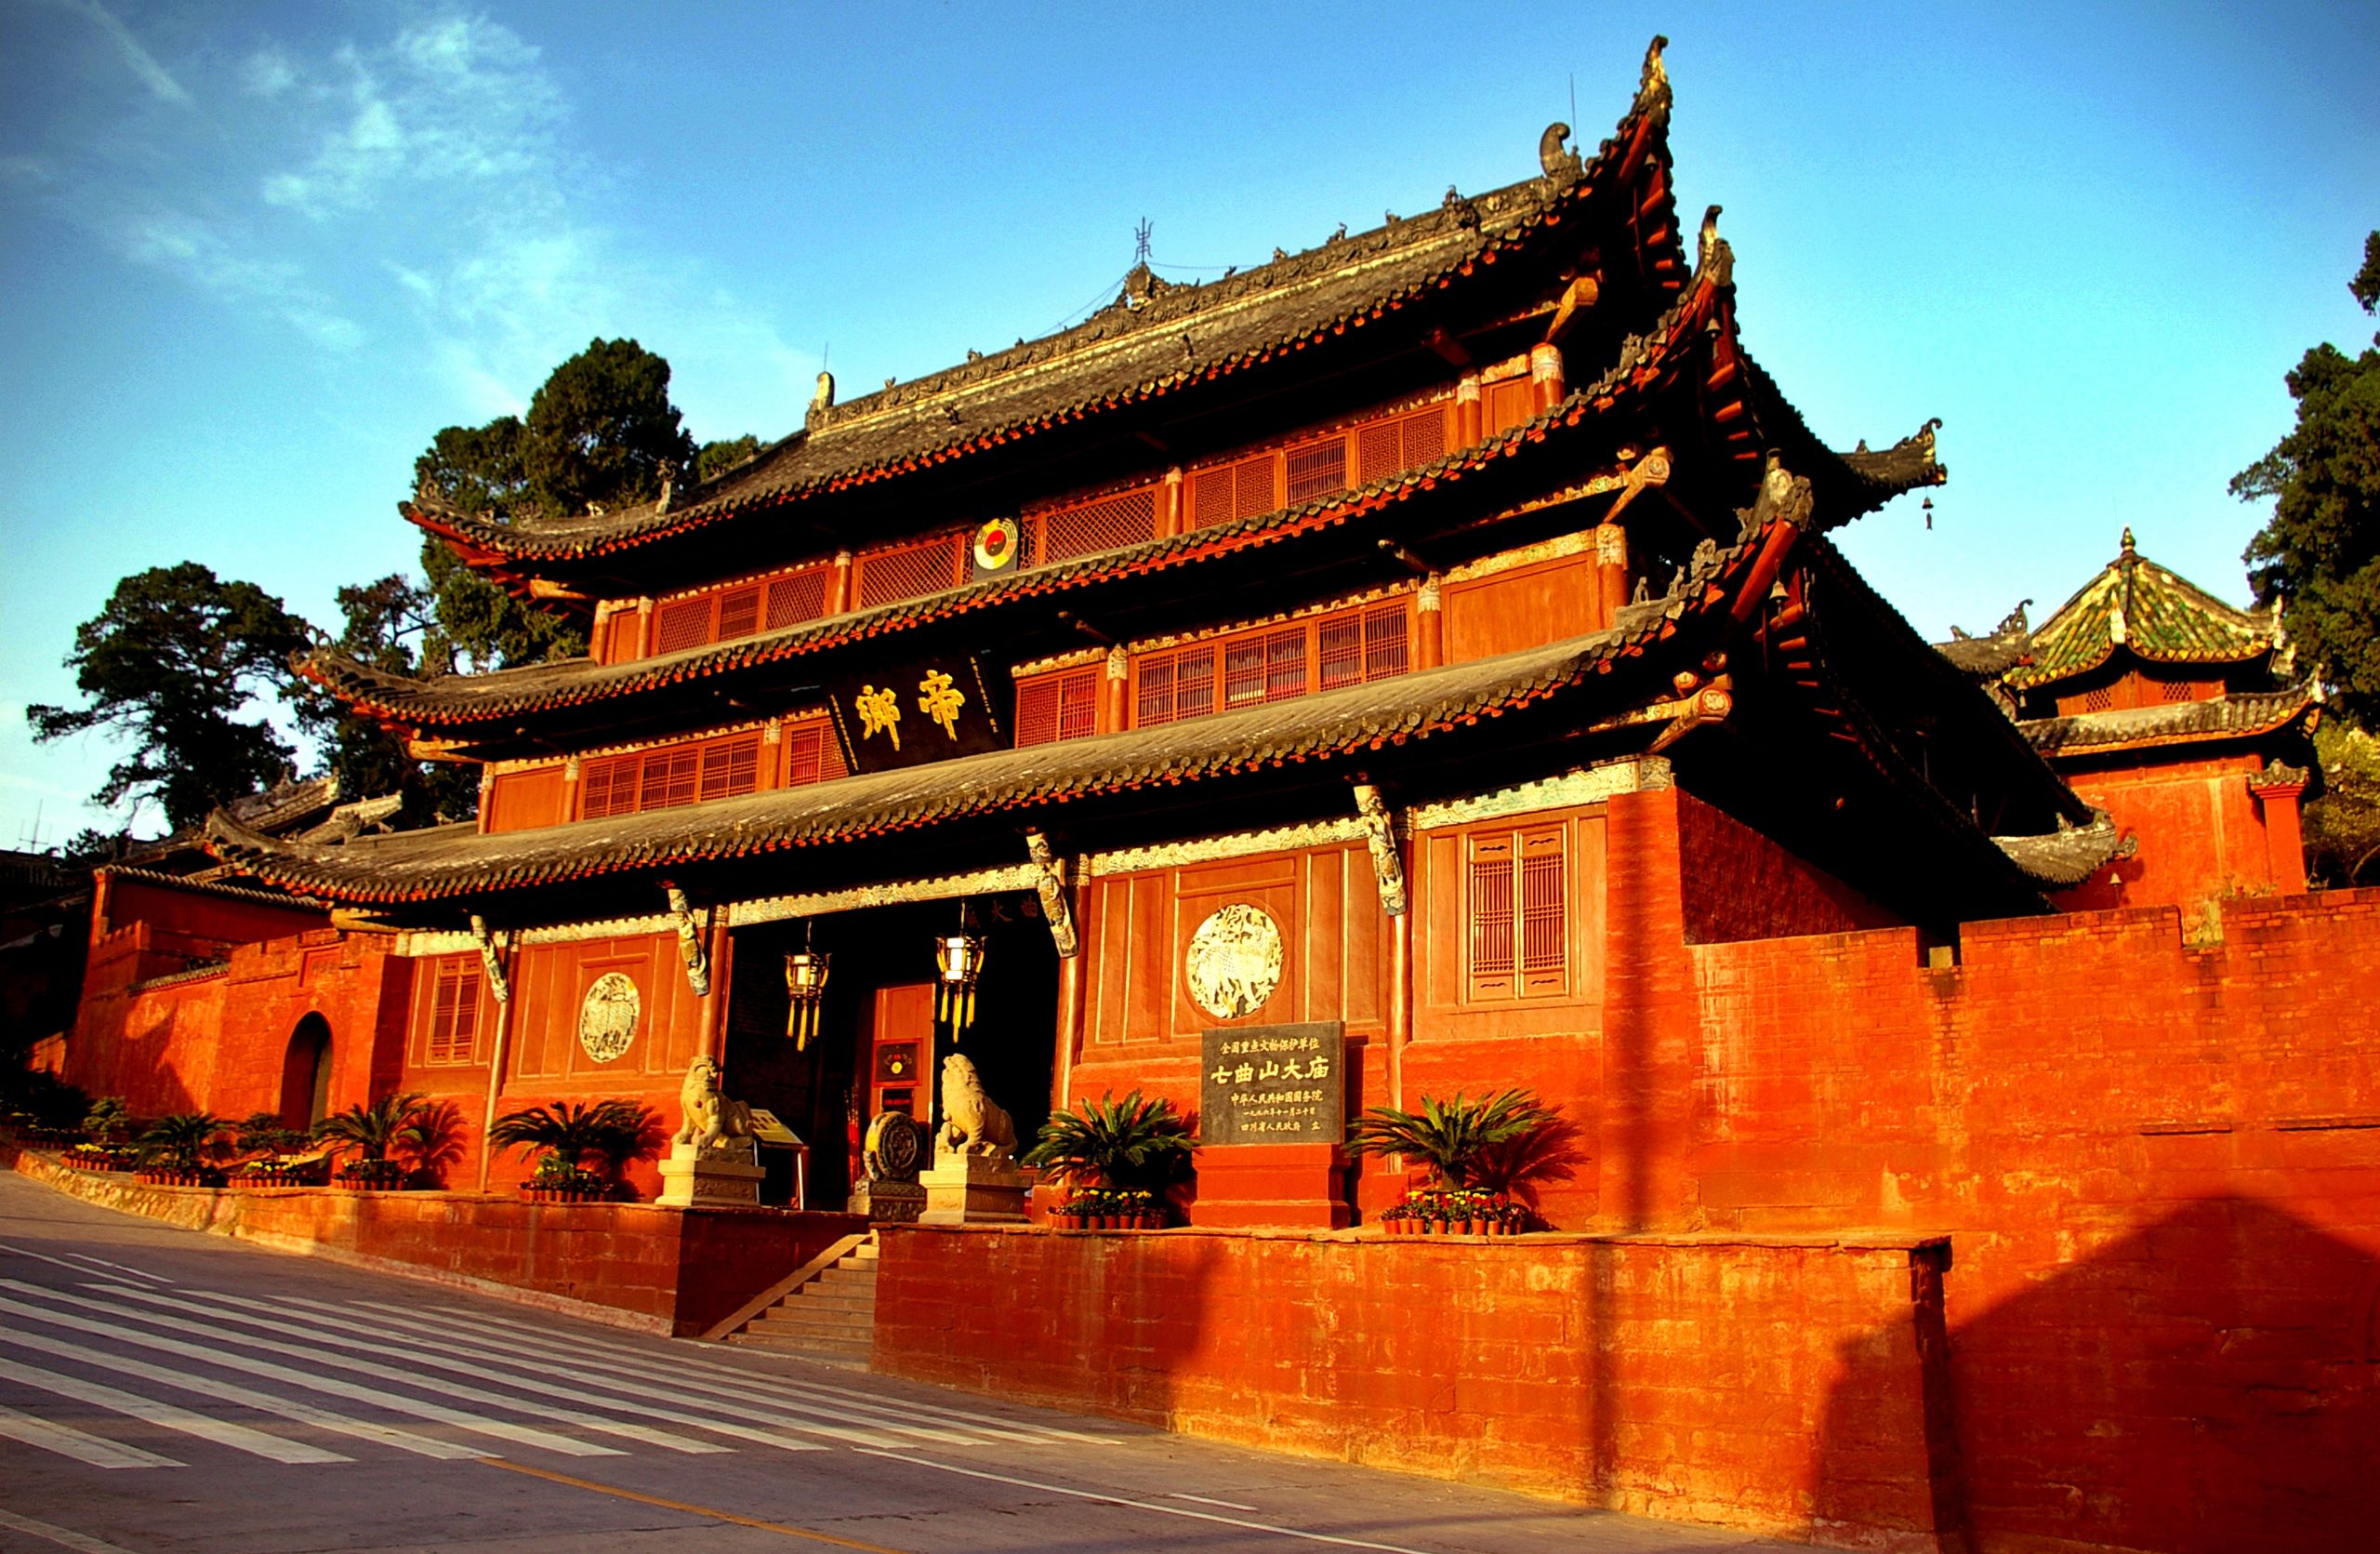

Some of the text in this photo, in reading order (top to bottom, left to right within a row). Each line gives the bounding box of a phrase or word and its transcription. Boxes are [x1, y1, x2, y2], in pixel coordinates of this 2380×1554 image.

[1220, 1037, 1320, 1055] 全国重点文物保护单位
[1210, 1056, 1329, 1084] 七曲山大庙
[1230, 1089, 1324, 1107] 中华人民共和国国务院
[1240, 1121, 1301, 1132] 四川省人民政府
